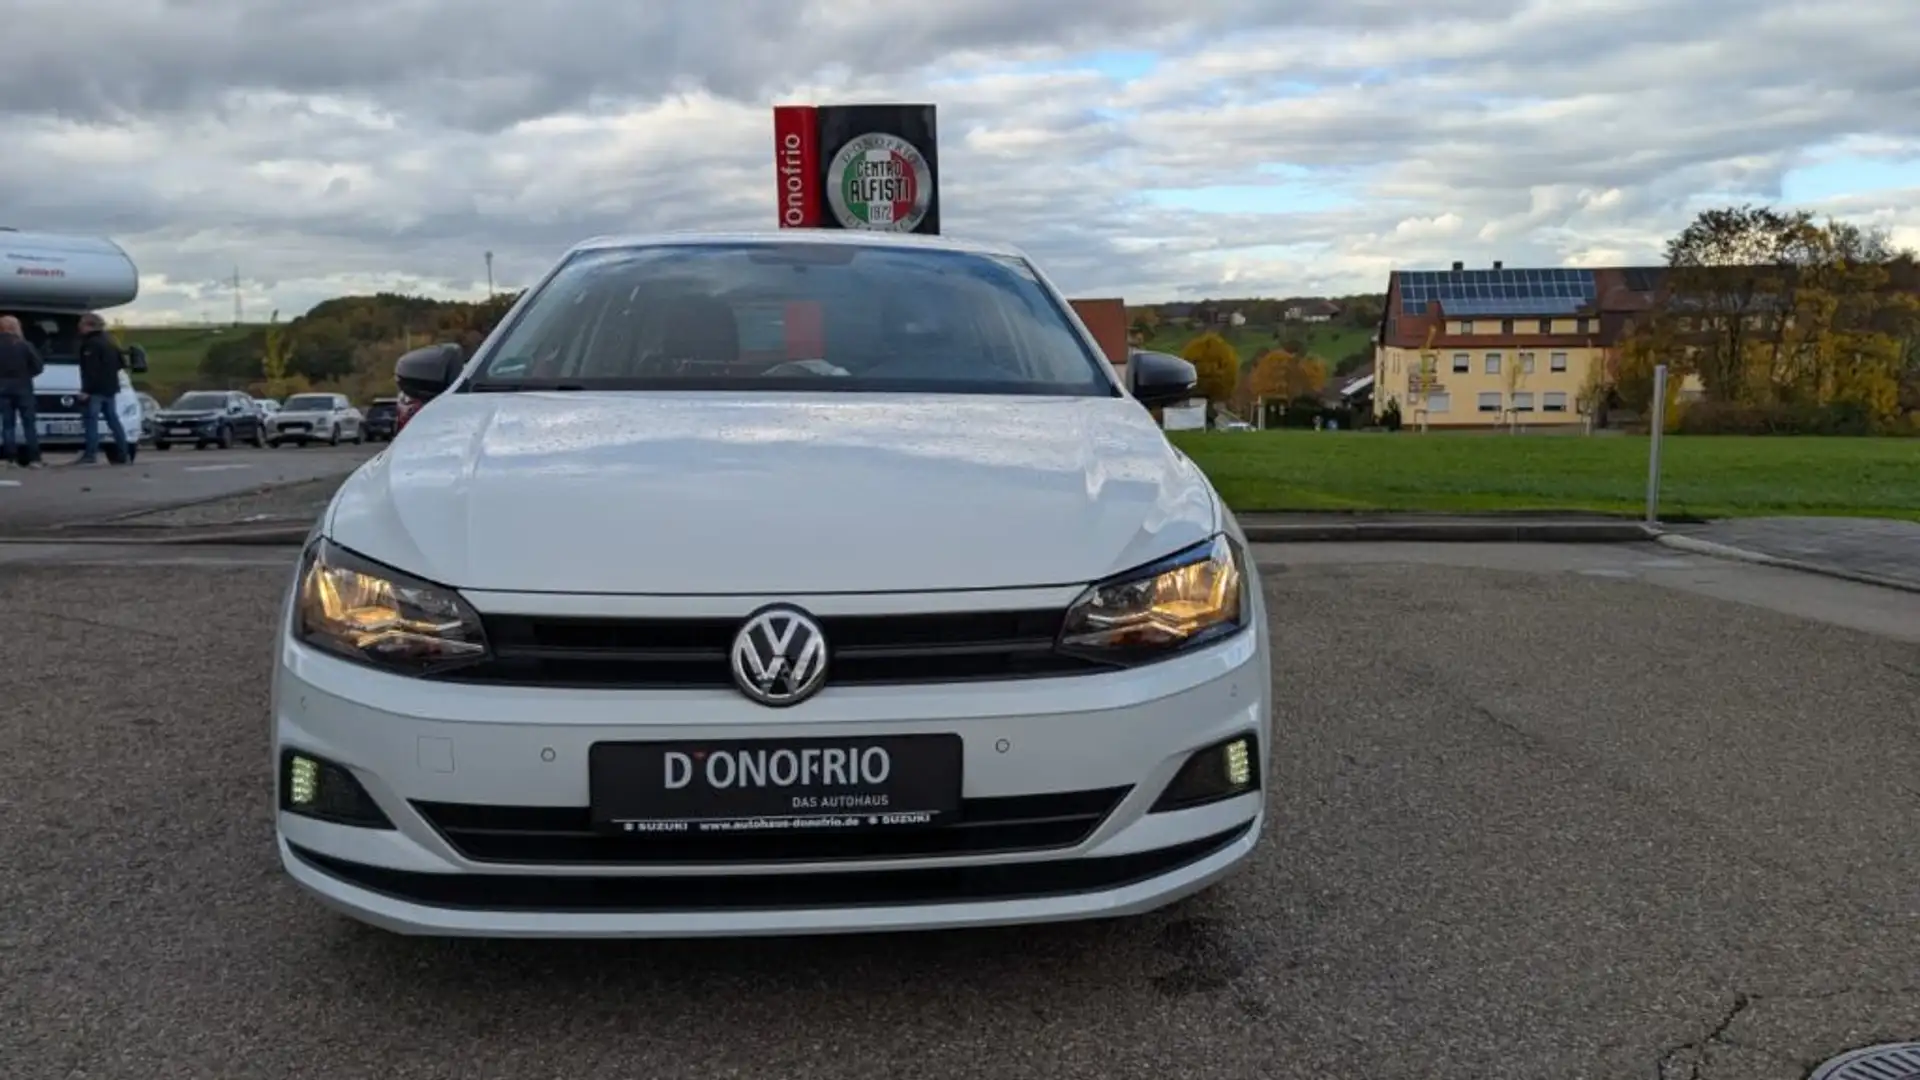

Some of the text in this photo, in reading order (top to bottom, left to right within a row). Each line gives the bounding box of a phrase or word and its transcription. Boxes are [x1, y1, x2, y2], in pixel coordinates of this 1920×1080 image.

[857, 160, 903, 177] CENTRO
[850, 178, 910, 203] ALFISTI
[792, 794, 890, 808] DAS AUTOHAUS
[637, 821, 688, 832] SUZUKI
[881, 813, 931, 825] SUZUKI
